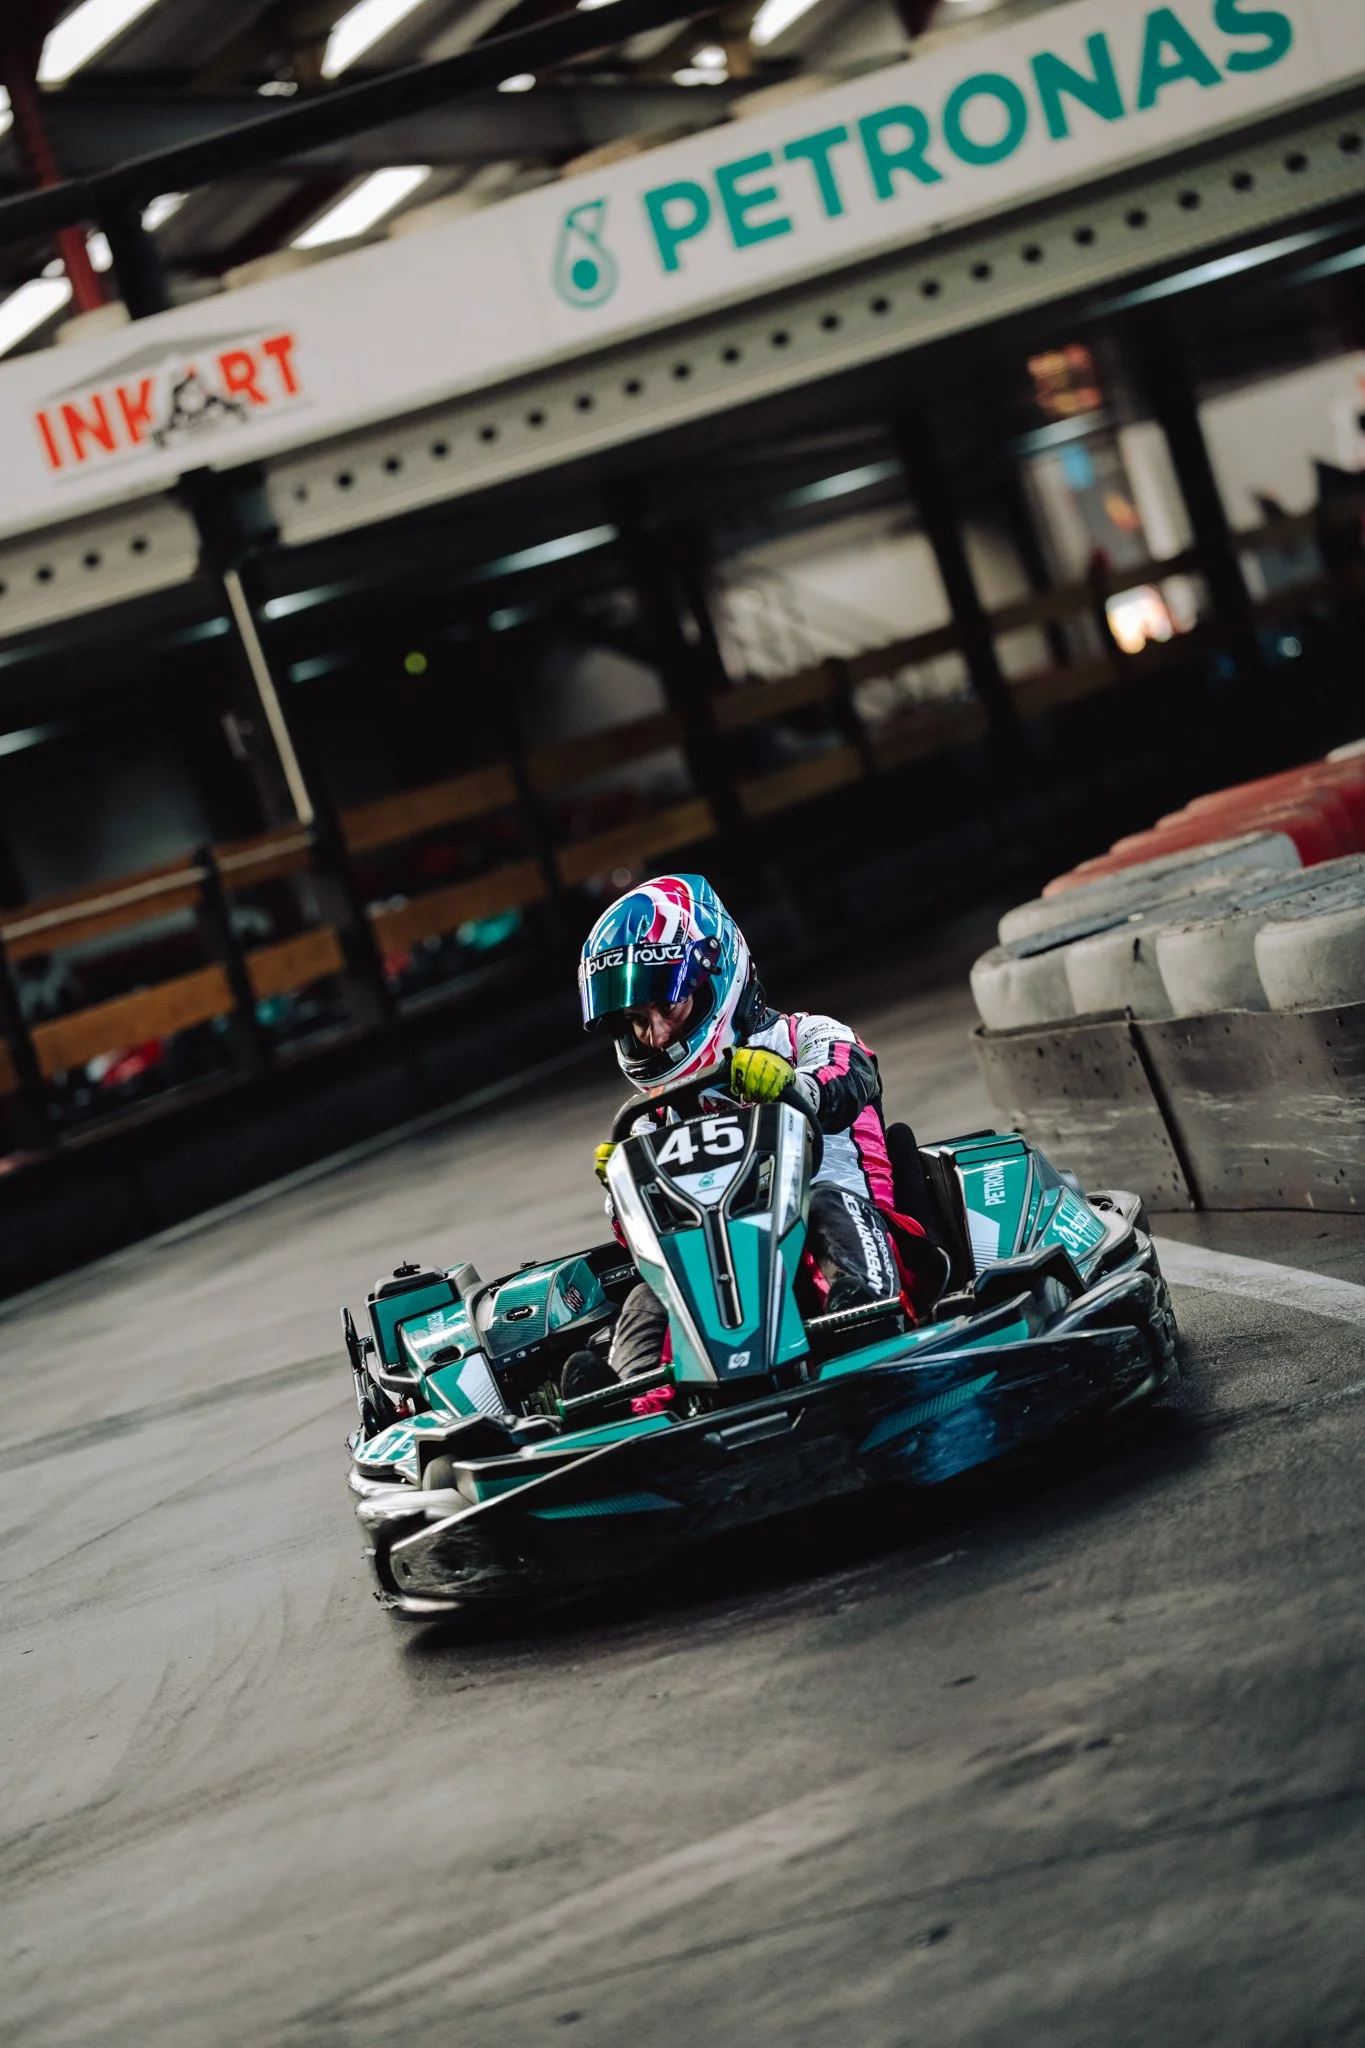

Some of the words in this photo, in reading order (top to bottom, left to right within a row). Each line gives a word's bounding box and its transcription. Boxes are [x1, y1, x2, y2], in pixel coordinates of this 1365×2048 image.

[645, 0, 1293, 272] PETRONAS
[656, 1116, 745, 1166] 45
[984, 1160, 1006, 1206] PETRONAS
